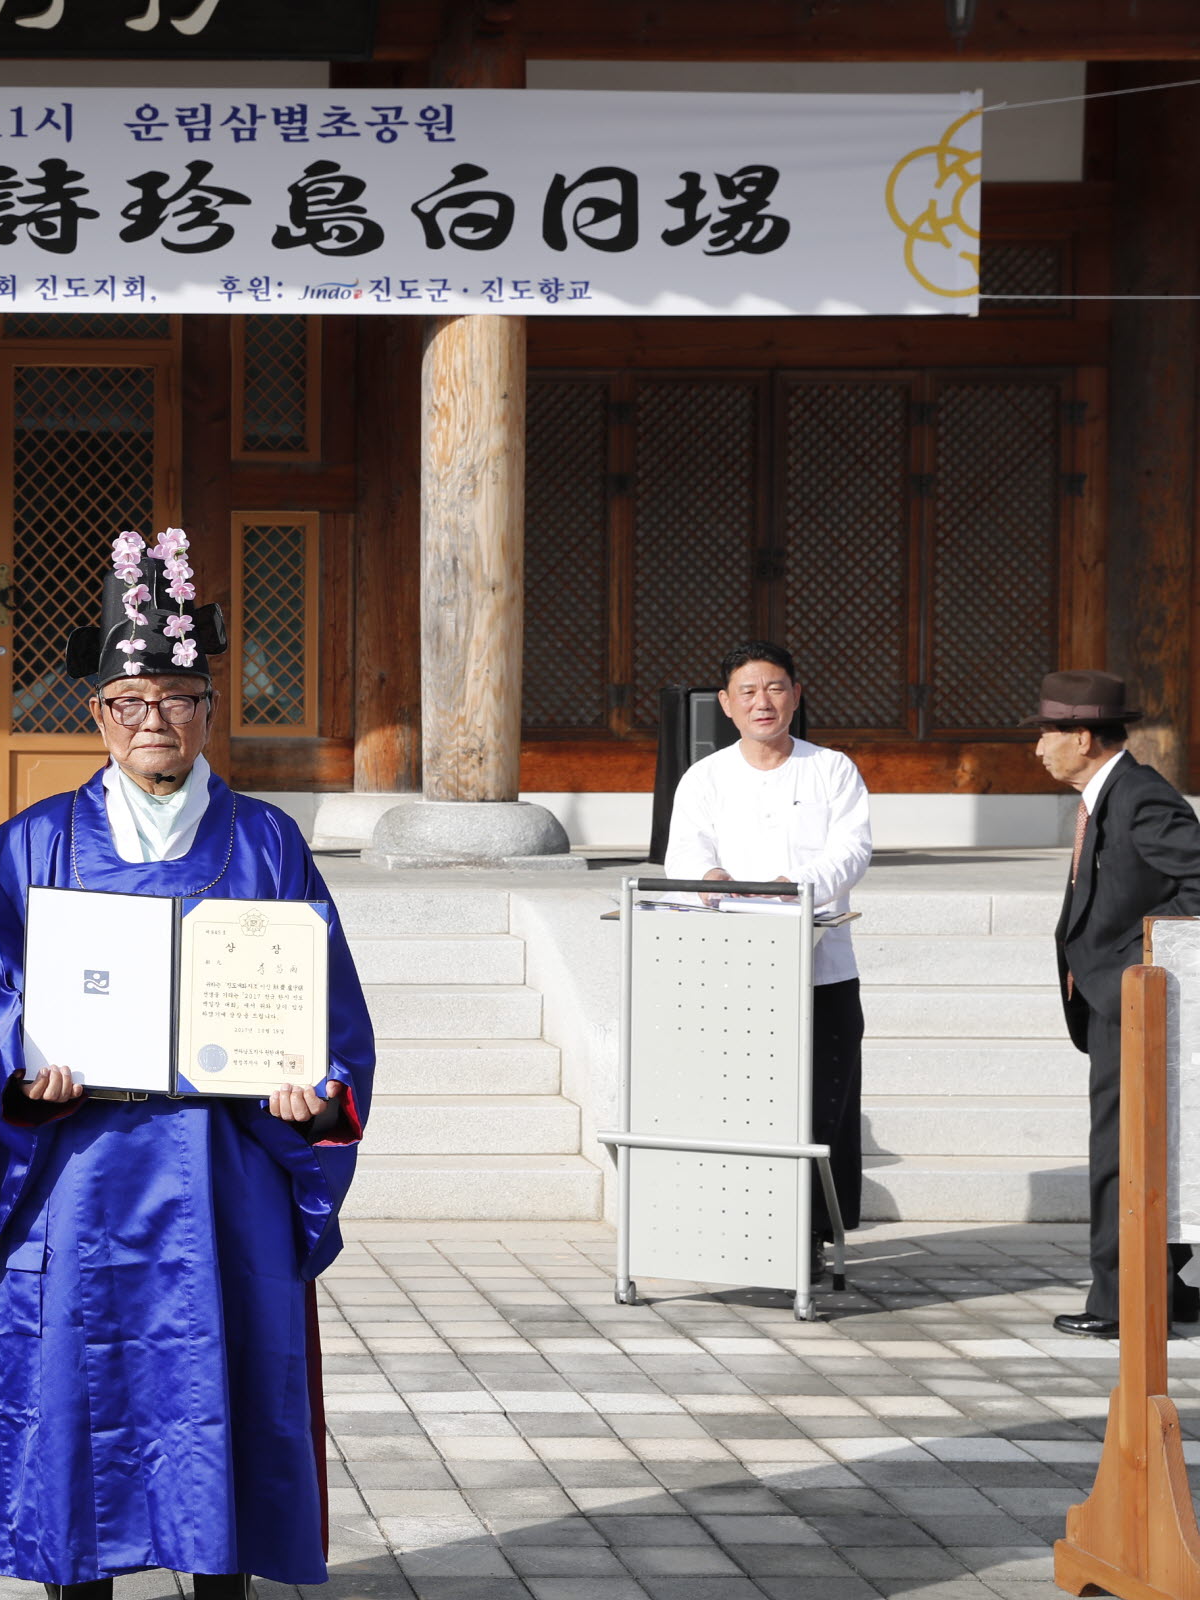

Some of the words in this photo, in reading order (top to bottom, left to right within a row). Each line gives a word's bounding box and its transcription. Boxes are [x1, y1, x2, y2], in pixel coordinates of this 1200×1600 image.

[124, 103, 458, 146] 운림삼별초공원
[35, 274, 158, 303] 진도지회,
[216, 275, 284, 303] 후원:
